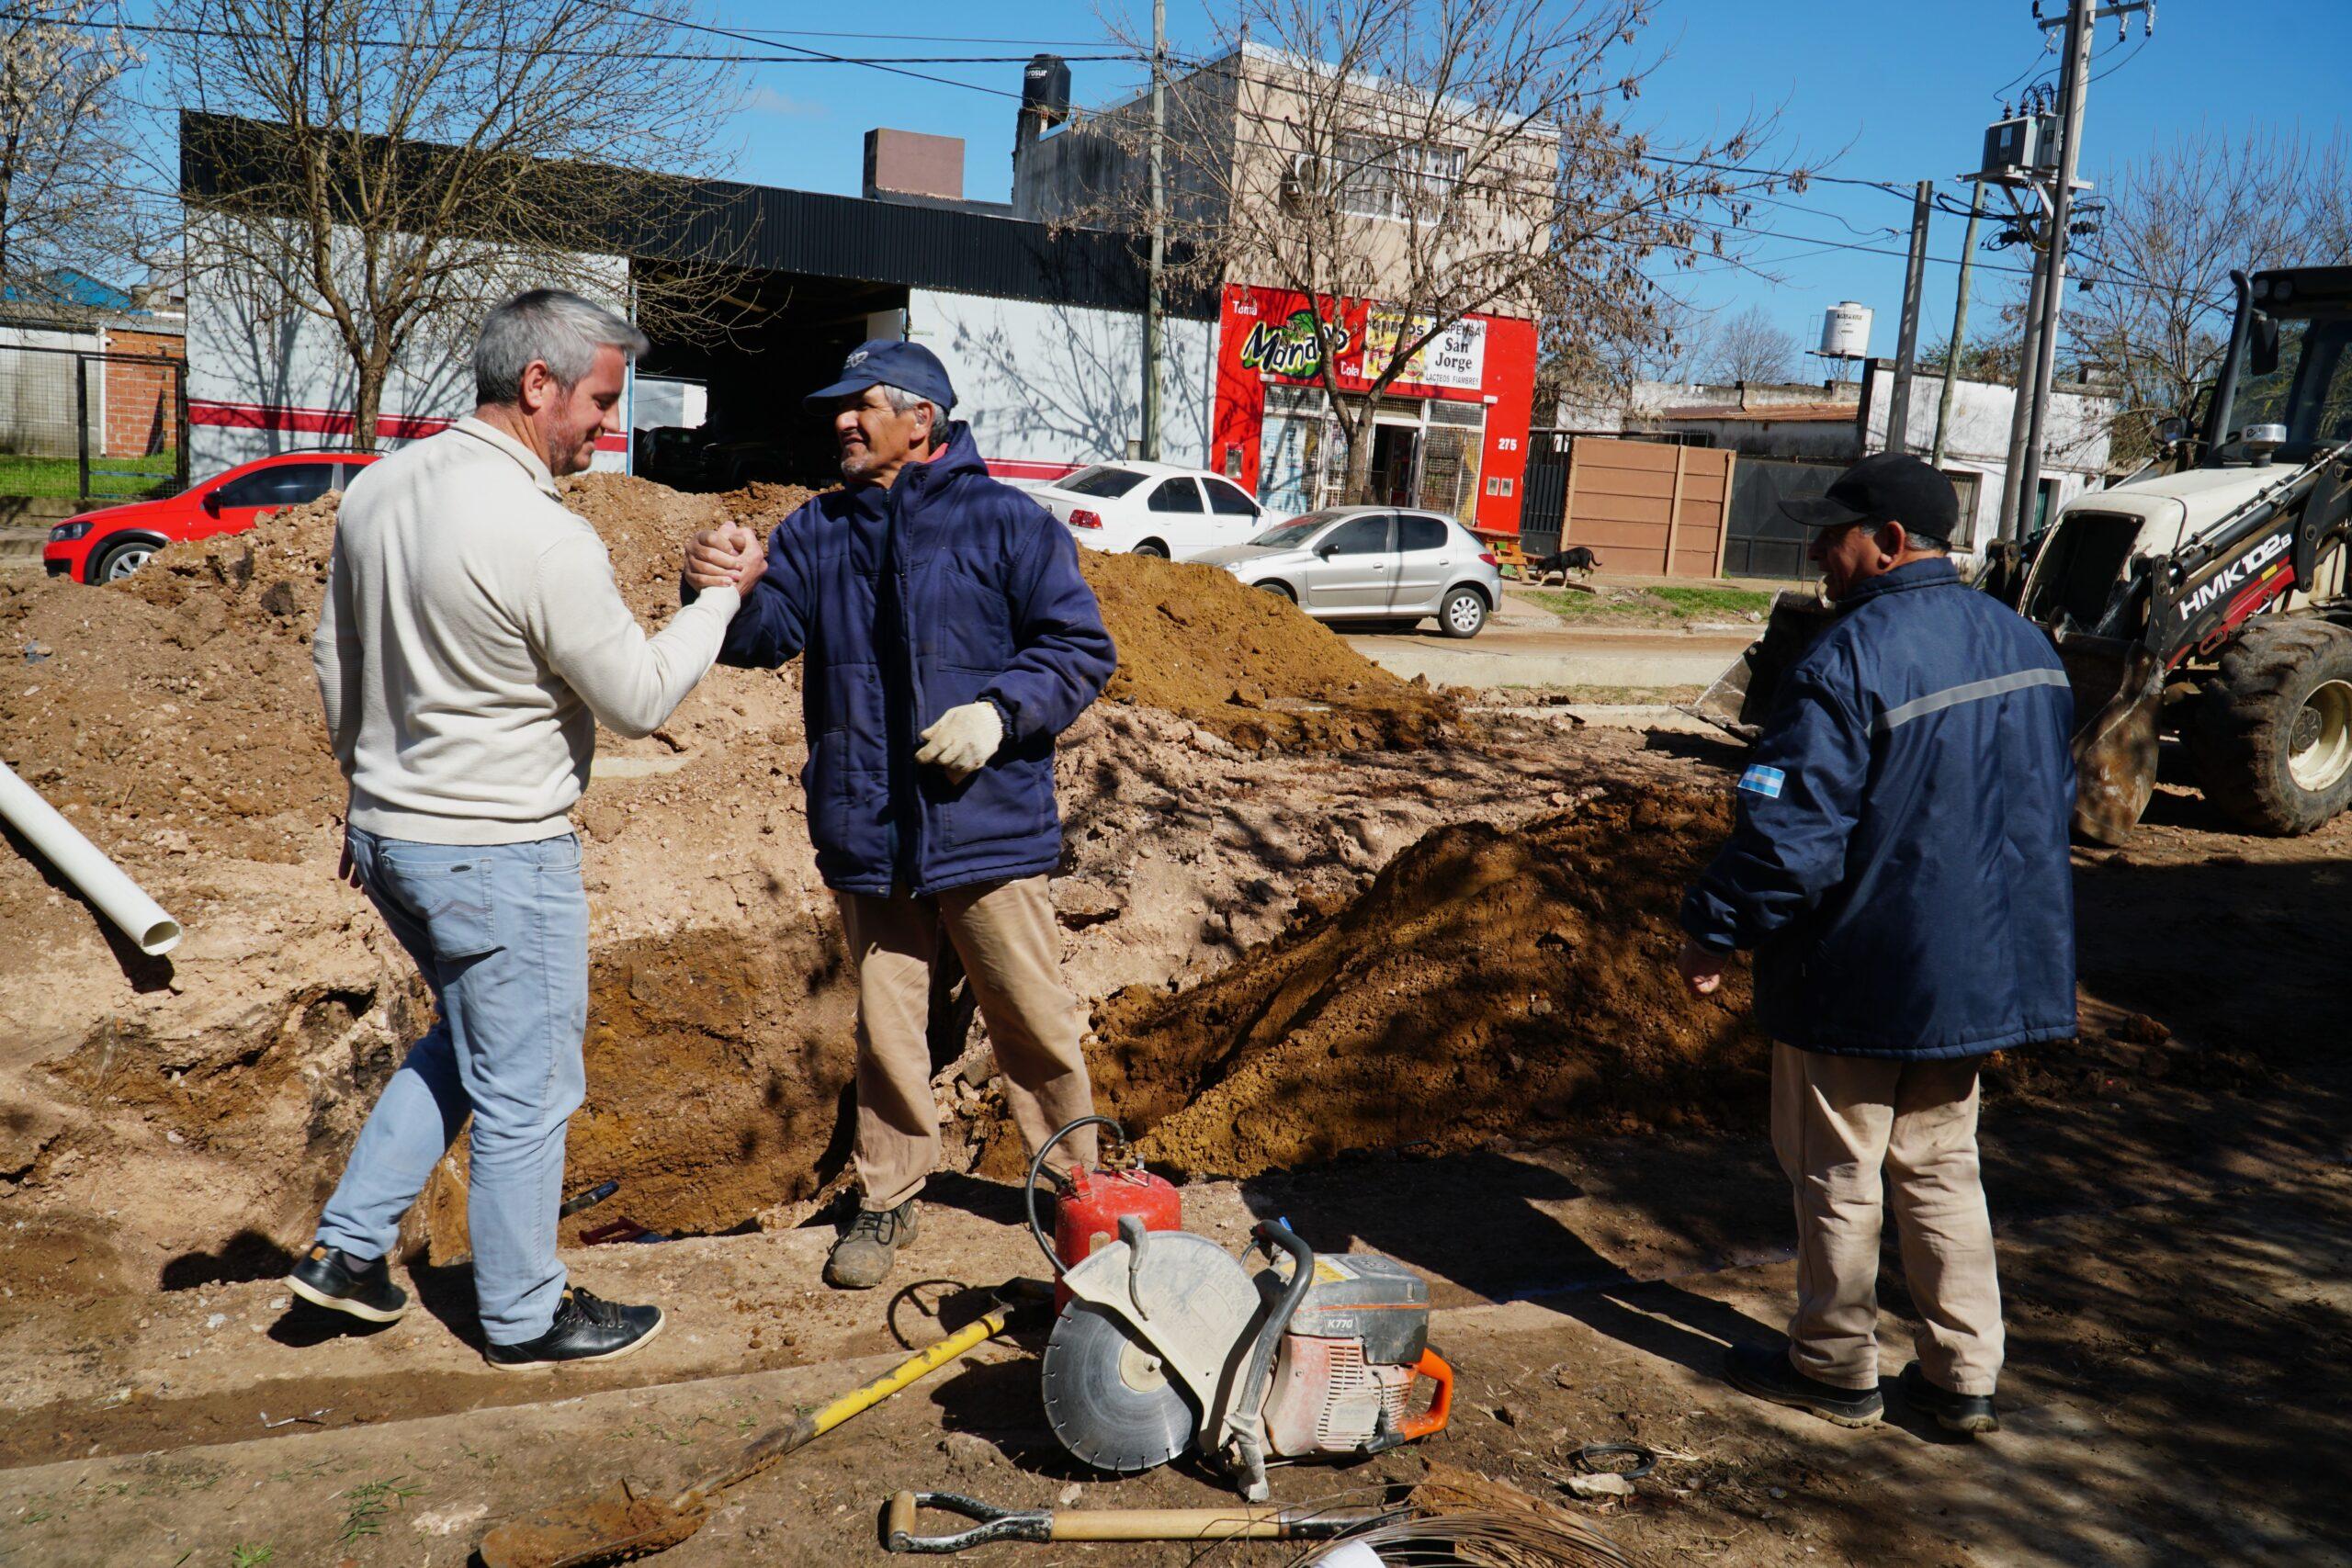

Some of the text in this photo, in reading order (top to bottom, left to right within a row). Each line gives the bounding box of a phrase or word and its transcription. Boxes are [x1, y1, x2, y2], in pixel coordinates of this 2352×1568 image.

[1444, 337, 1469, 353] San
[1340, 360, 1360, 376] Cola
[1435, 352, 1473, 372] Jorge
[1498, 437, 1518, 451] 275
[1327, 1318, 1354, 1329] K770
